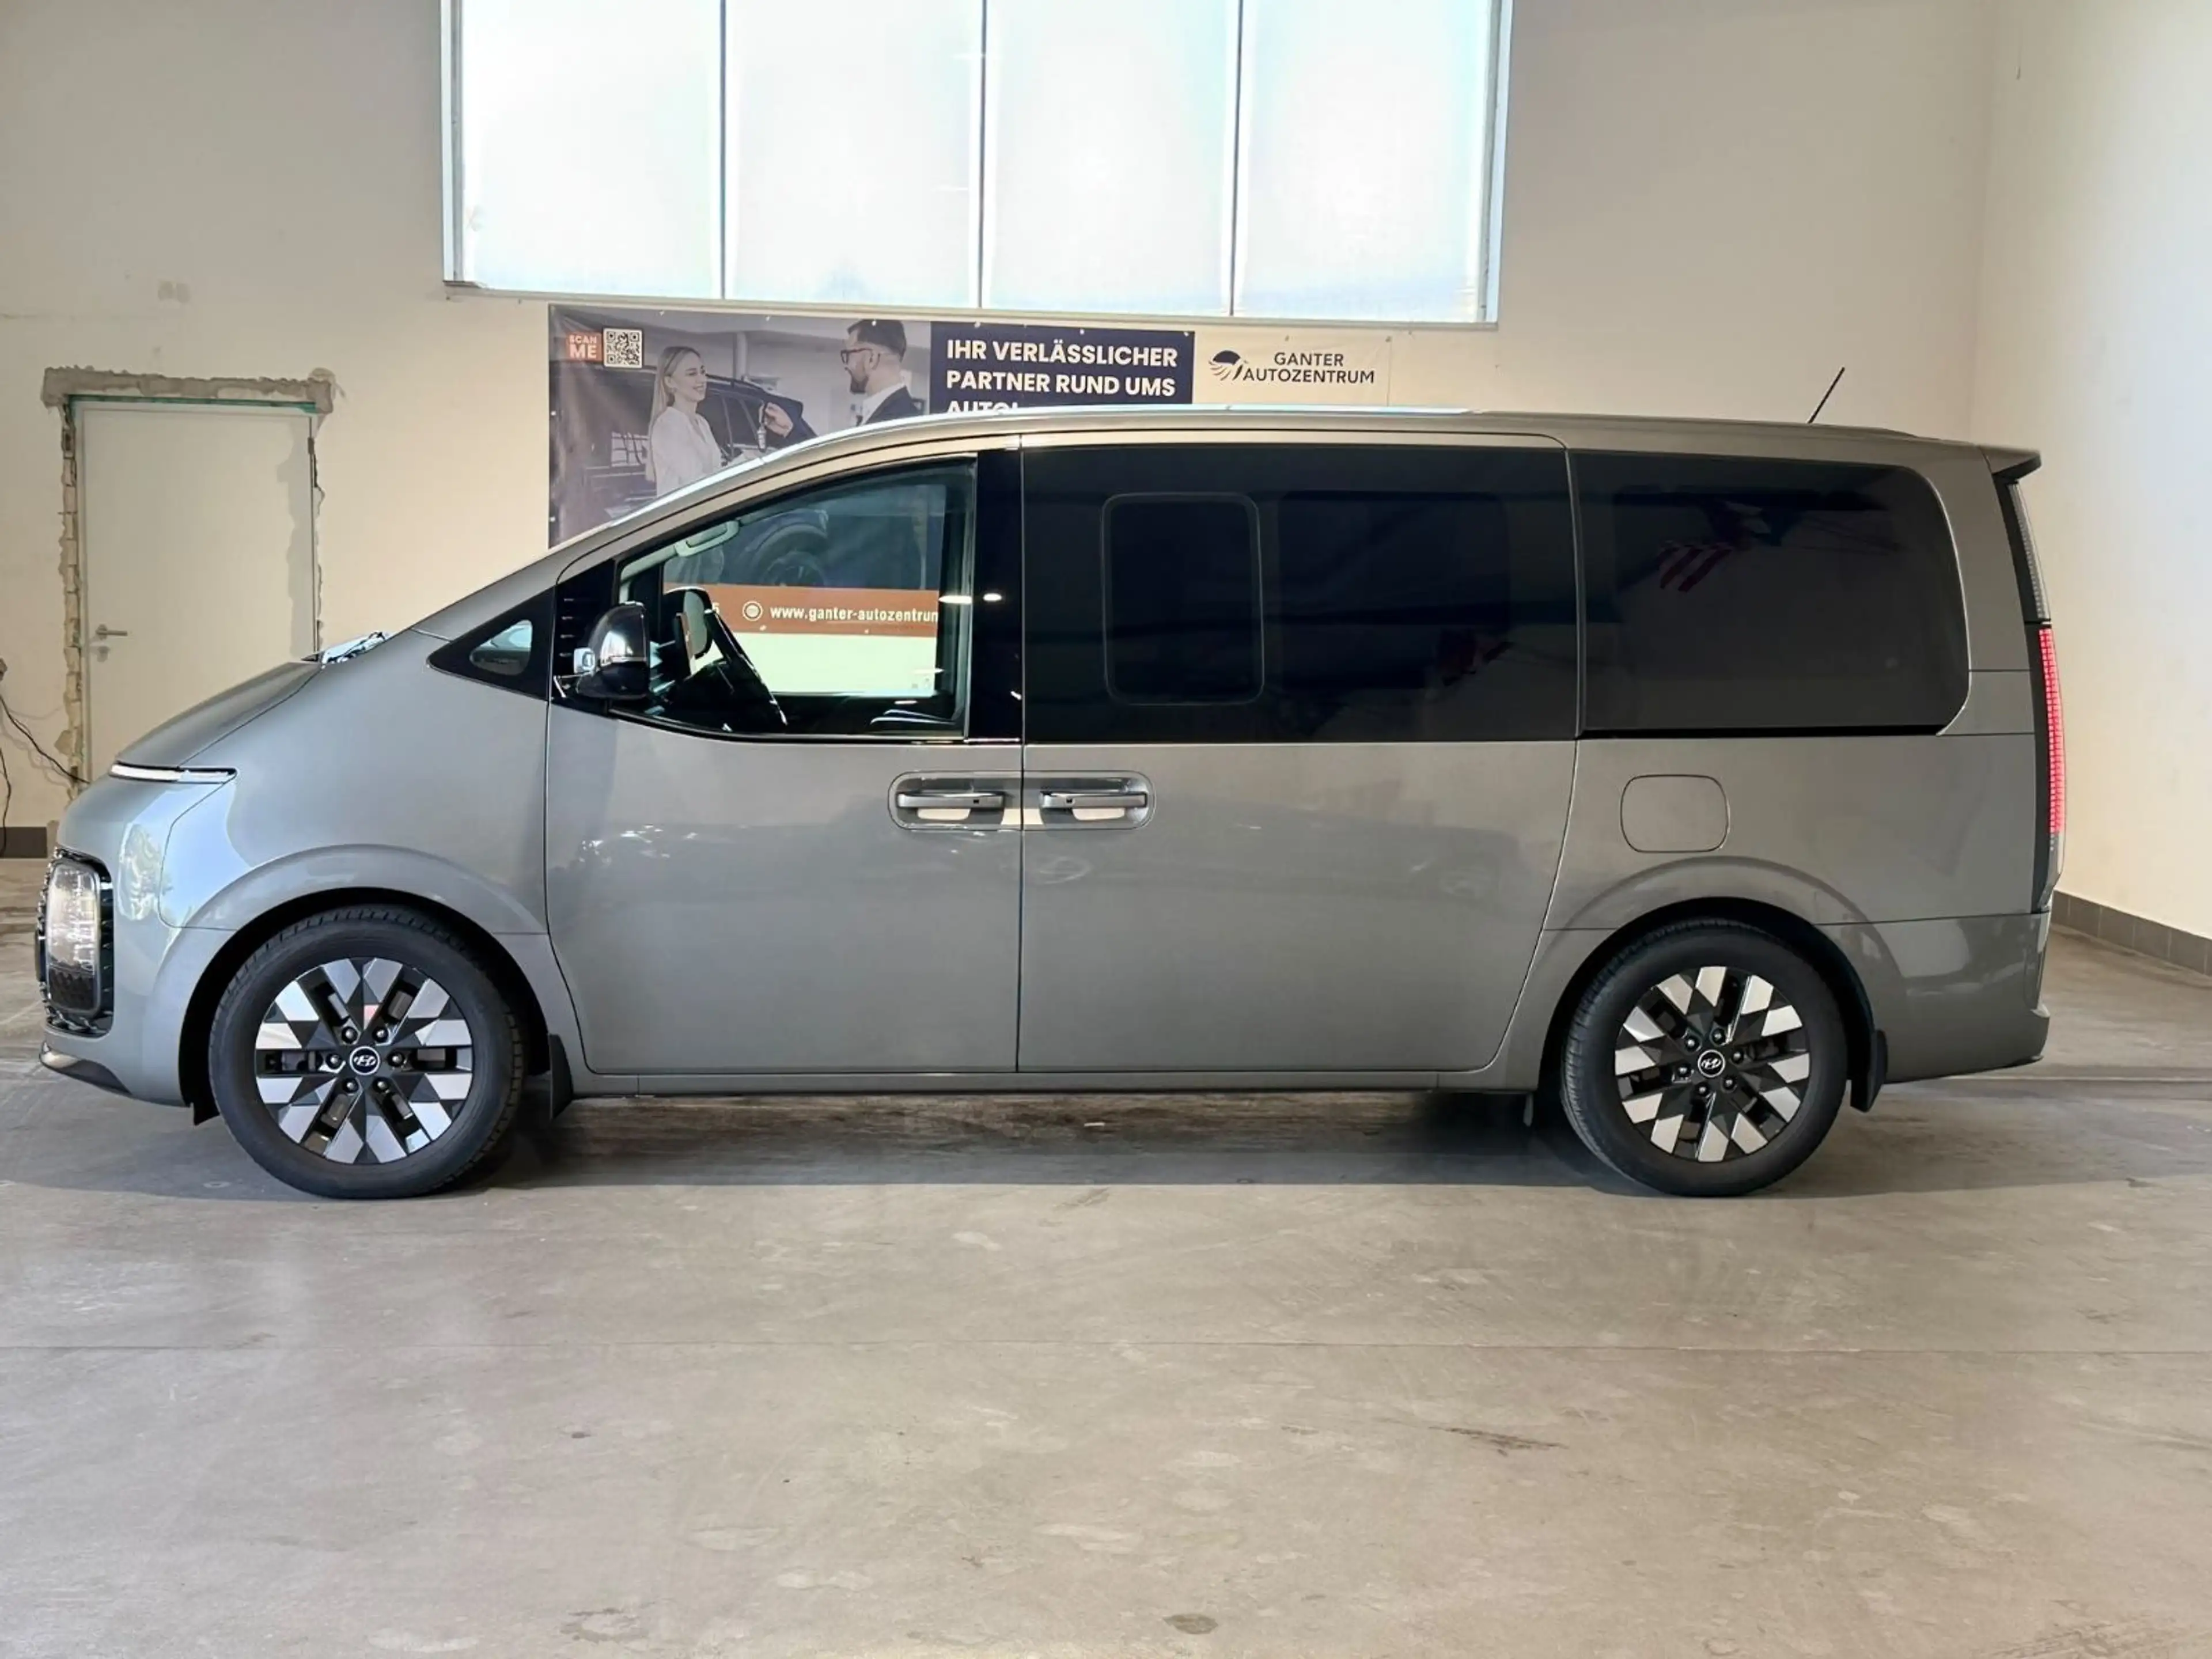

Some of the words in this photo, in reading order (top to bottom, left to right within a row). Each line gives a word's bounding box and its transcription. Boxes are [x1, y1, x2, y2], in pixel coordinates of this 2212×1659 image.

[569, 335, 597, 343] SCAN
[569, 344, 597, 359] ME
[948, 339, 987, 359] IHR
[993, 339, 1177, 367] VERLÄSSLICHER
[1274, 352, 1343, 366] GANTER
[946, 370, 1050, 392] PARTNER
[1056, 374, 1120, 395] RUND
[1125, 377, 1175, 396] UMS
[1243, 368, 1374, 384] AUTOZENTRUM
